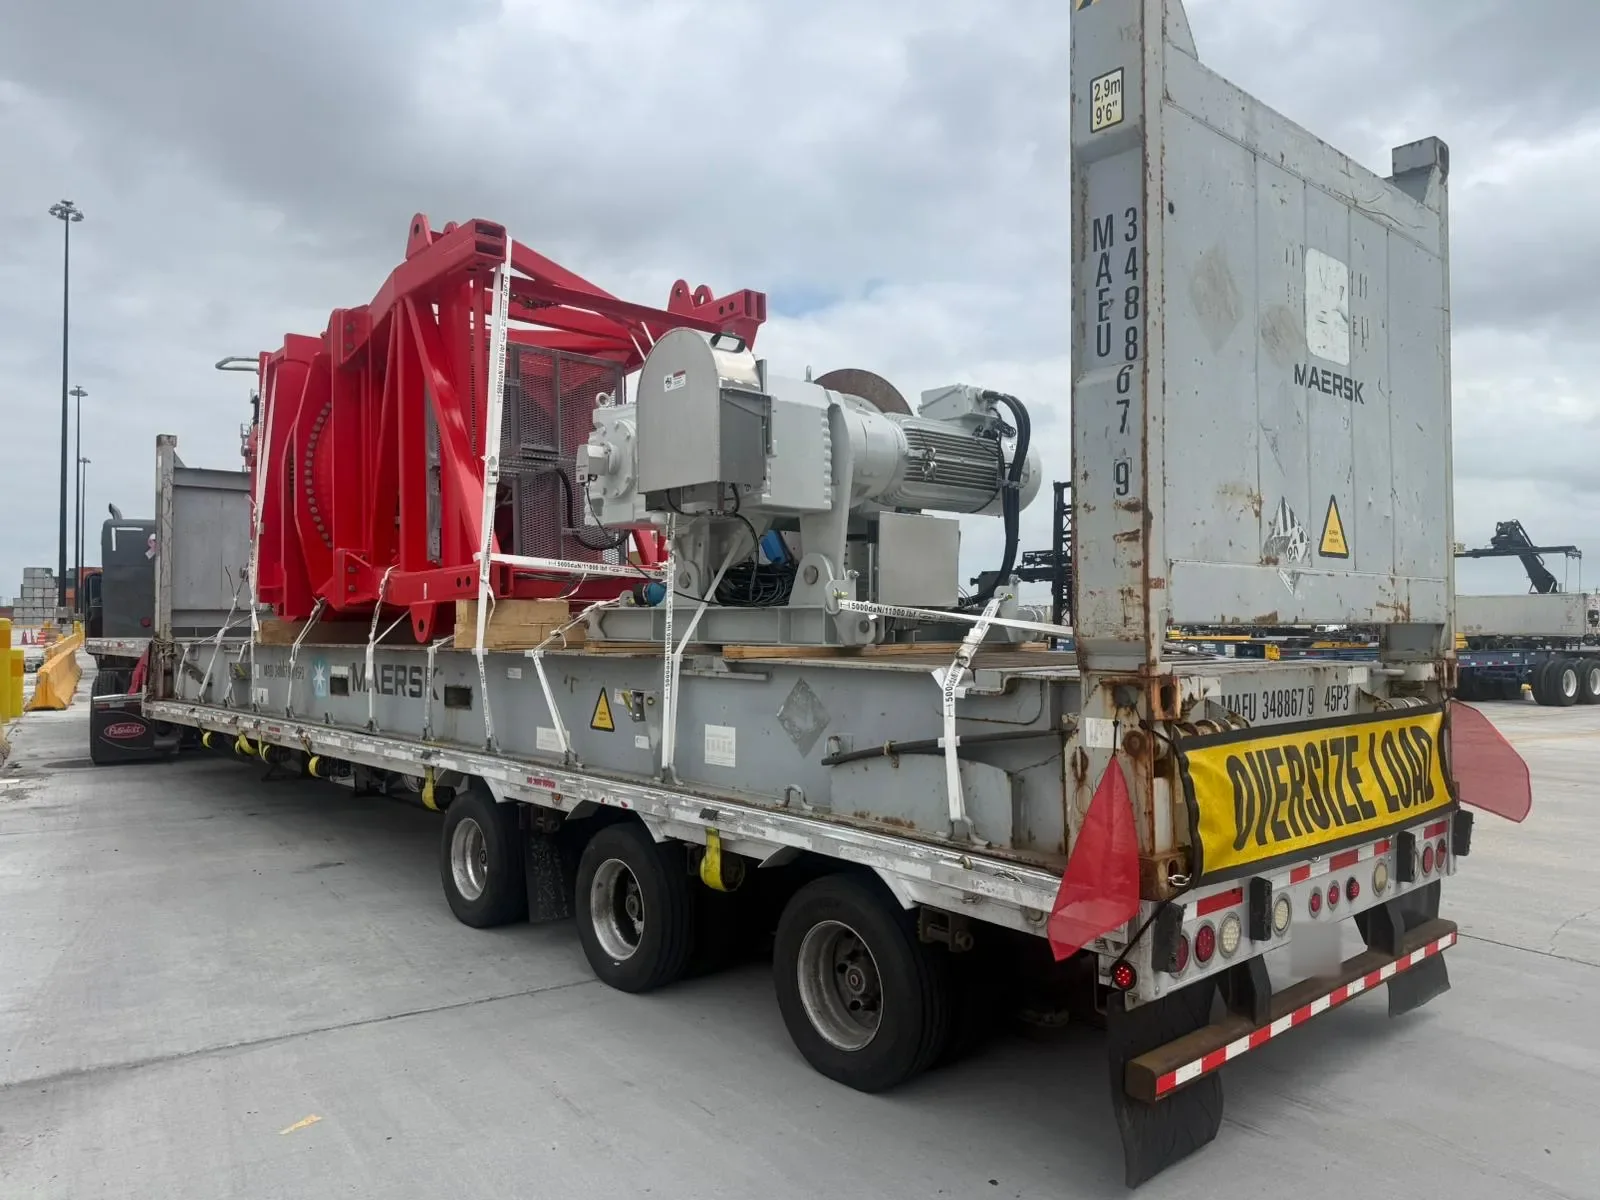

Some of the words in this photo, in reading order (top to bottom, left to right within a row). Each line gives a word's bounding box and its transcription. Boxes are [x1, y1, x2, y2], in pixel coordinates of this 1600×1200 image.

[1094, 79, 1121, 103] 2,9m
[1096, 100, 1118, 125] 9'6"
[1294, 363, 1365, 405] MAERSK
[352, 662, 440, 700] MAERSK
[1262, 688, 1304, 720] 348867
[1307, 686, 1315, 717] 9
[1324, 684, 1350, 712] 45P3
[1226, 735, 1378, 851] OVERSIZE
[1368, 725, 1435, 814] LOAD
